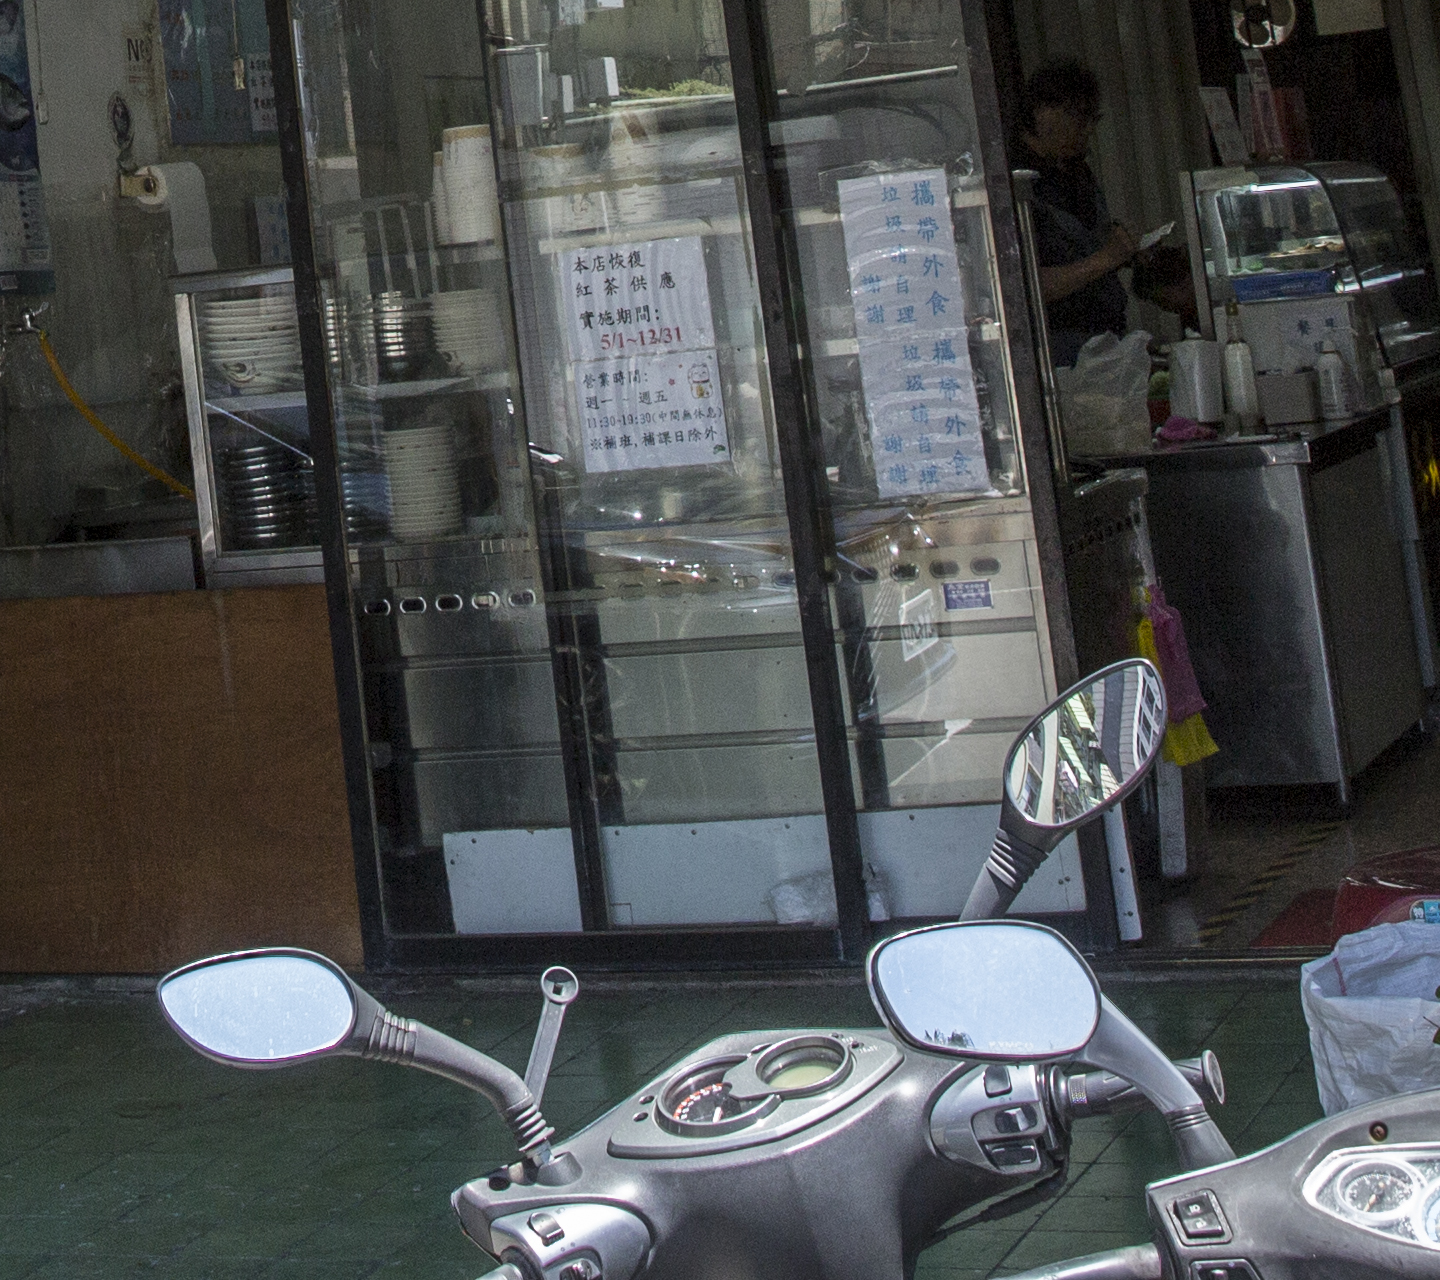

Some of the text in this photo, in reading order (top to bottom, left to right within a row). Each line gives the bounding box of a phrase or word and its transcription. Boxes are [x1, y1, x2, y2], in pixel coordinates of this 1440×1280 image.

[572, 250, 646, 274] 本店恢復
[600, 326, 683, 351] 5/1~12/31
